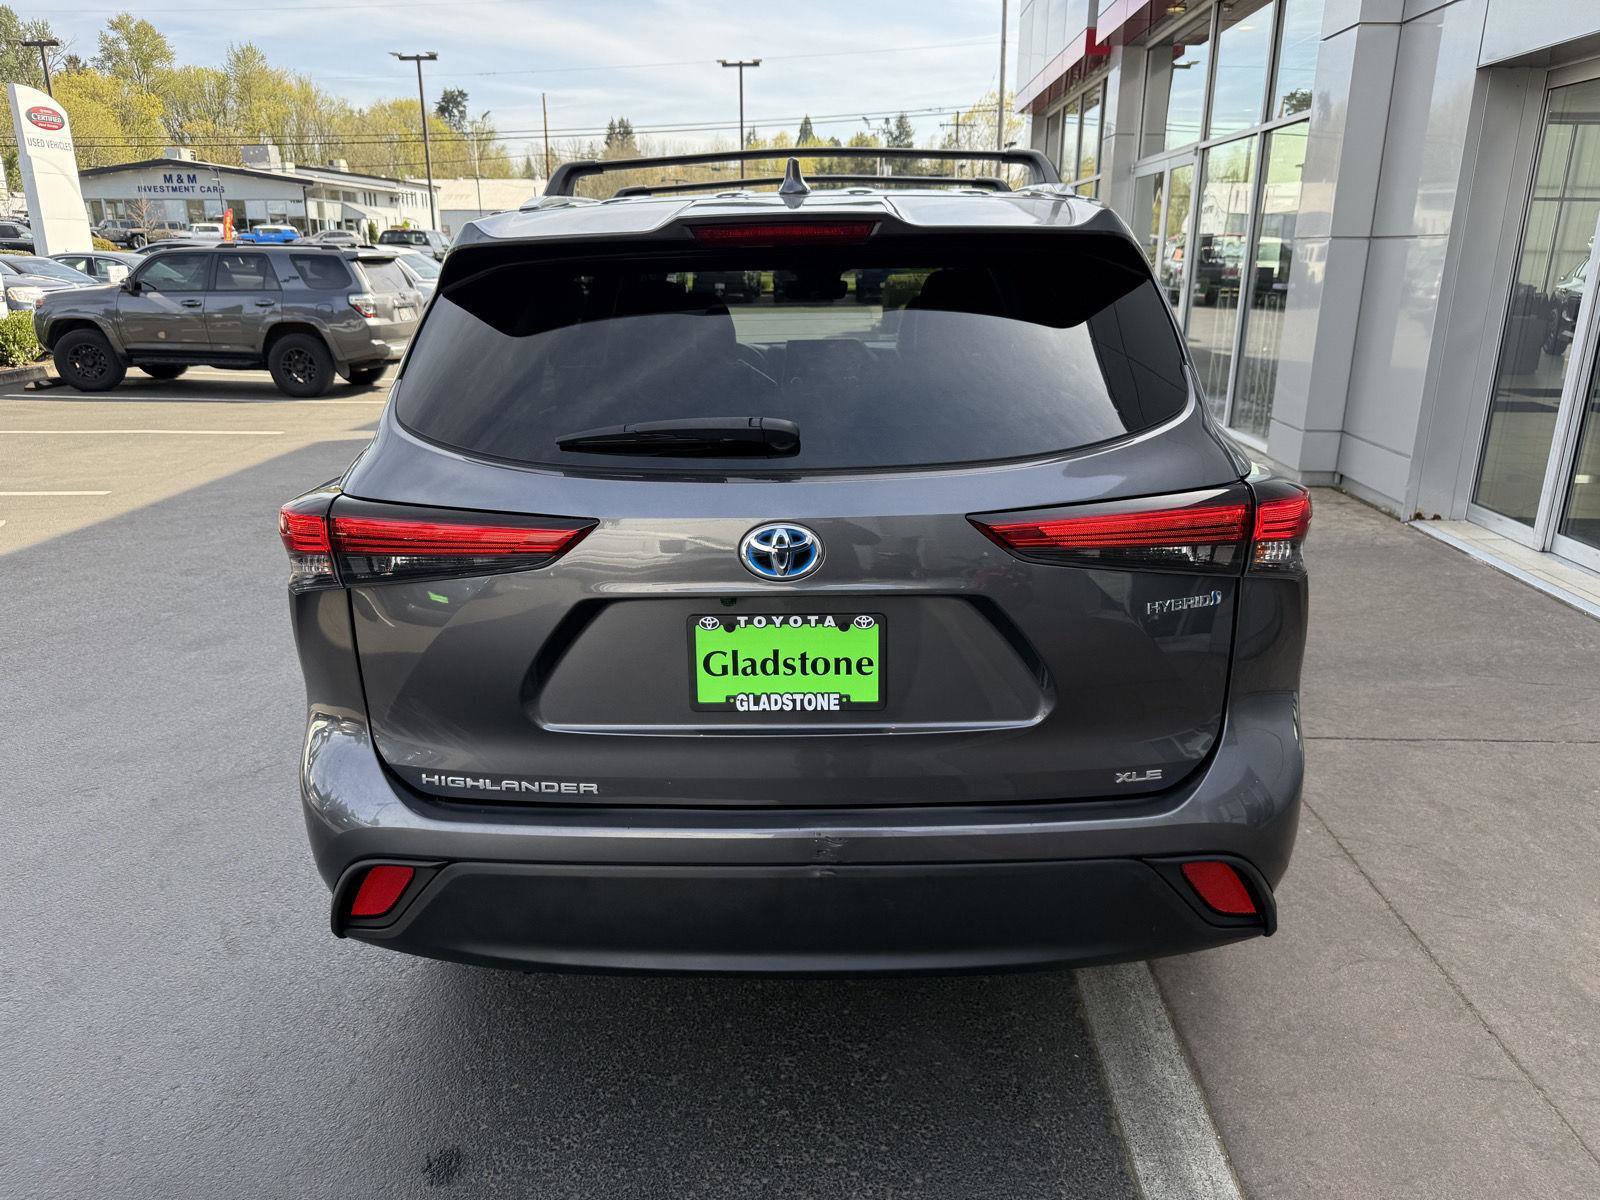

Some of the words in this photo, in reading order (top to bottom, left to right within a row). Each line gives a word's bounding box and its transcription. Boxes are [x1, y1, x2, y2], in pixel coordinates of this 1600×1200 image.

[27, 137, 45, 148] USED
[46, 140, 72, 152] VEHICLES
[163, 173, 174, 184] M
[176, 174, 185, 184] &
[187, 173, 198, 184] M
[137, 185, 196, 193] INVESTMENT
[200, 185, 225, 194] CARS
[1146, 594, 1211, 615] HYBRID
[736, 615, 837, 628] TOYOTA
[702, 649, 875, 677] Gladstone
[735, 693, 841, 712] GLADSTONE
[421, 773, 599, 795] HIGHLANDER
[1115, 769, 1163, 784] XLE
